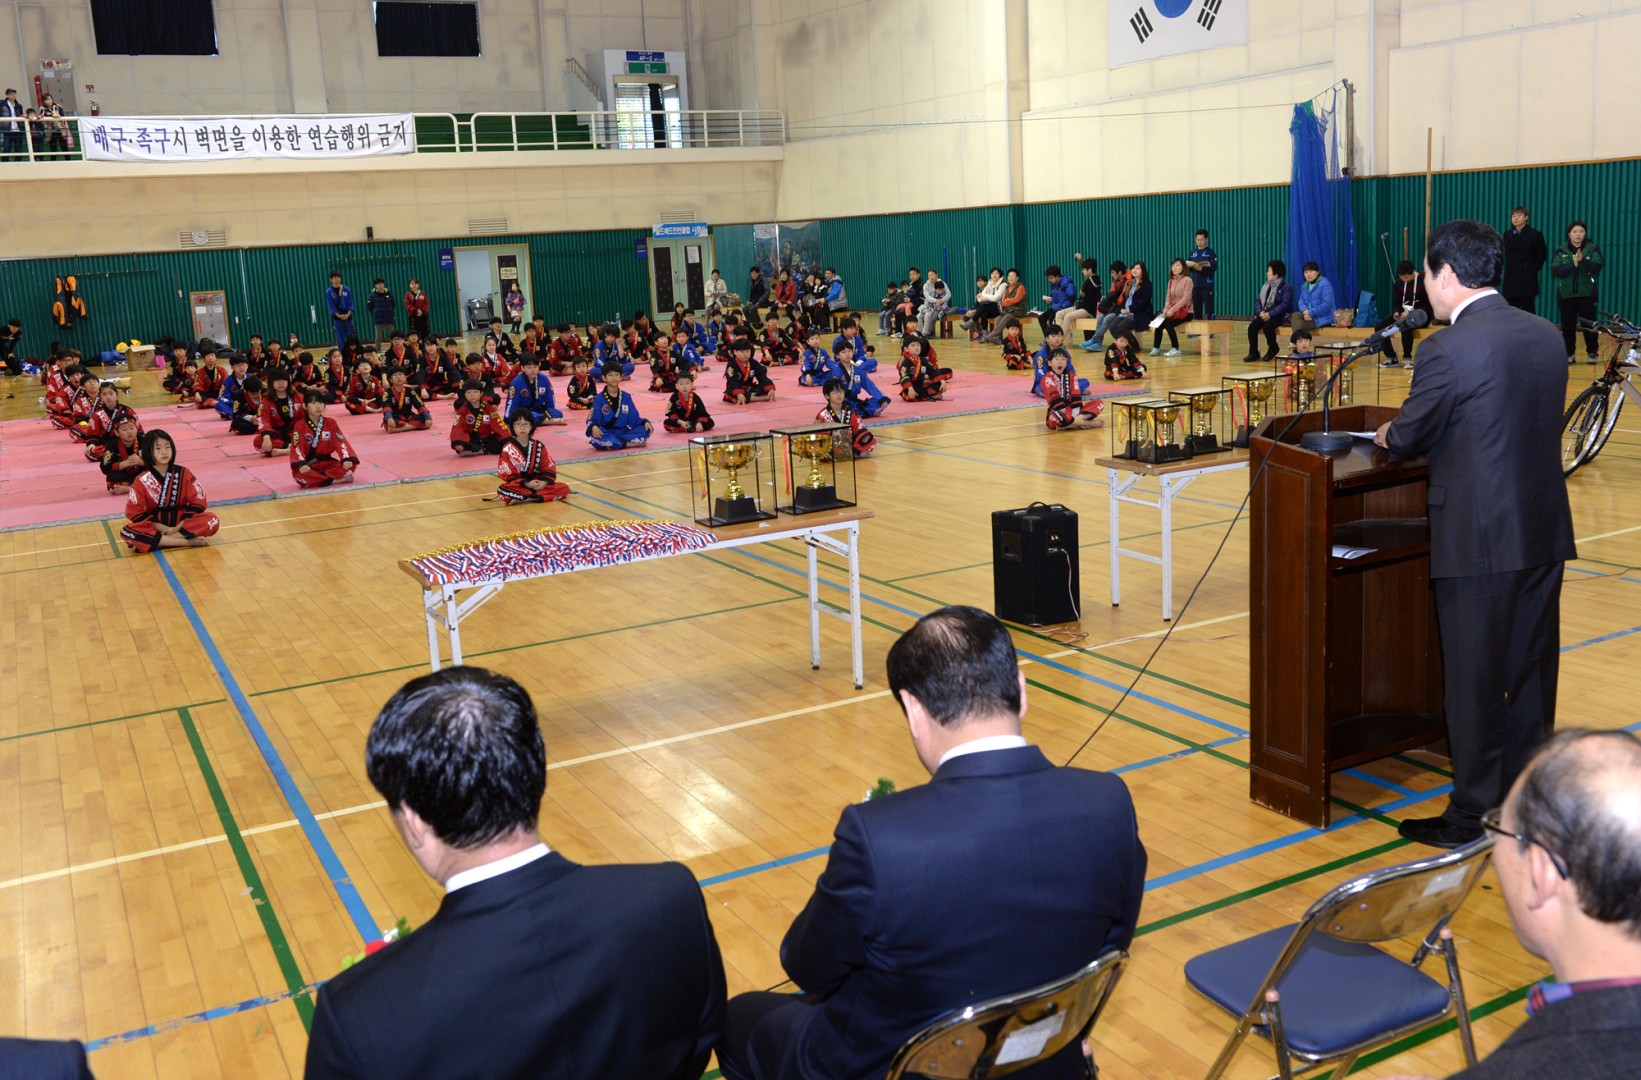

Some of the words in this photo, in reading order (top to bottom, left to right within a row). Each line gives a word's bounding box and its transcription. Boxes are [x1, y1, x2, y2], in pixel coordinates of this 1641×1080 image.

[91, 124, 188, 154] 배구·족구시
[194, 124, 246, 153] 벽면을
[252, 124, 302, 151] 이용한
[308, 122, 371, 151] 연습행위
[377, 120, 407, 147] 금지
